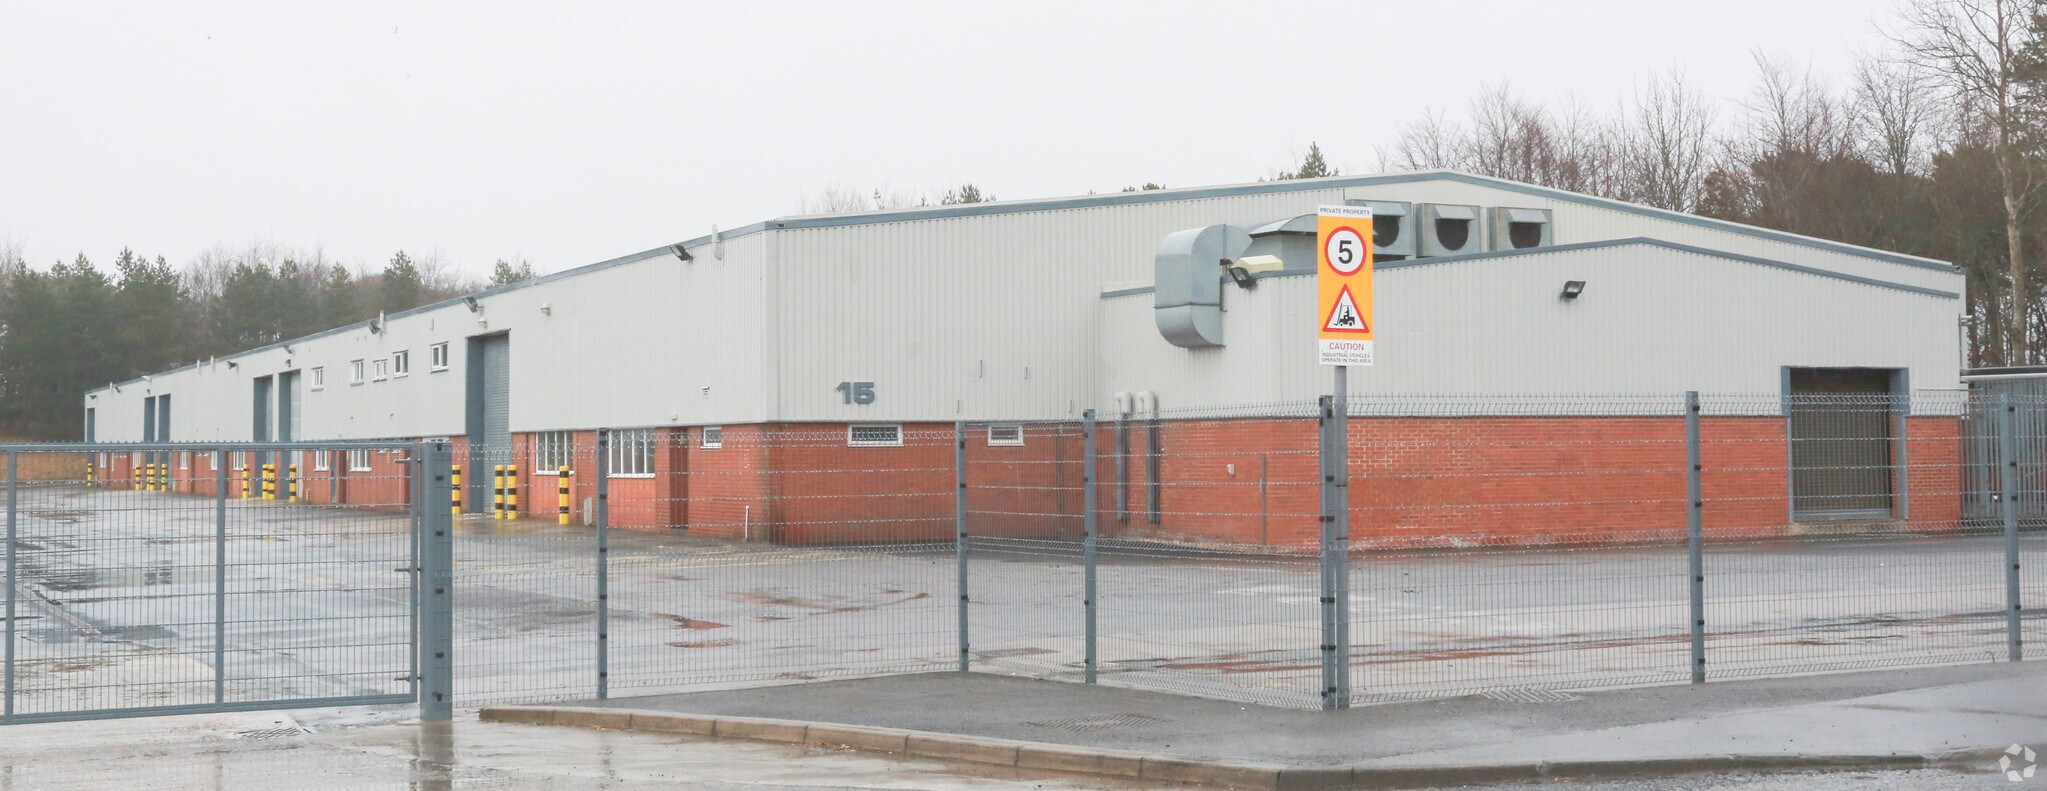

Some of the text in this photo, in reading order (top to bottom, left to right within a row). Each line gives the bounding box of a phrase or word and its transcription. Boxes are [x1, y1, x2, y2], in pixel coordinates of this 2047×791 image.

[1338, 240, 1353, 264] 5
[1329, 342, 1365, 350] CAUTION
[835, 381, 876, 405] 15
